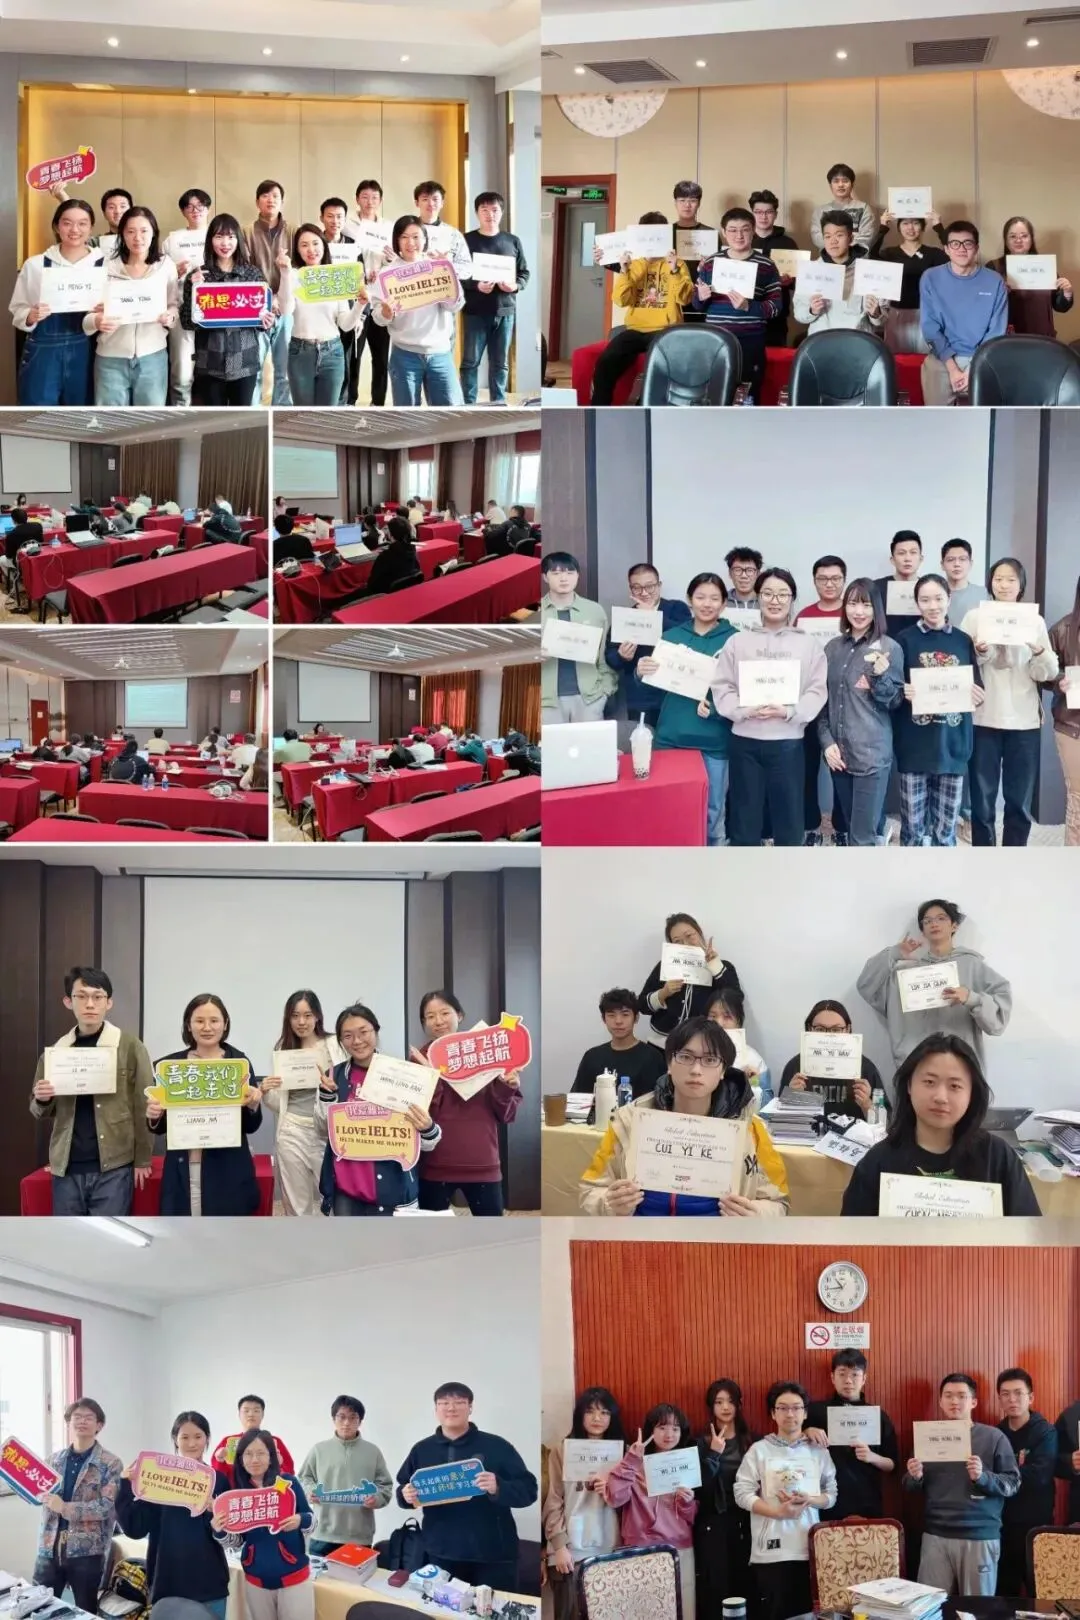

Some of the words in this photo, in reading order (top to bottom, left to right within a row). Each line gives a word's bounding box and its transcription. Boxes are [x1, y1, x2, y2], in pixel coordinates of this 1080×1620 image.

[394, 284, 416, 294] LOVE
[416, 275, 452, 290] IELTS!
[199, 292, 264, 311] 雅思必过
[446, 1030, 509, 1056] 青春飞扬
[447, 1047, 511, 1073] 梦想起航
[166, 1063, 238, 1084] 青春我们
[170, 1082, 240, 1100] 一起走过
[336, 1126, 340, 1134] I
[342, 1126, 366, 1135] LOVE
[368, 1125, 411, 1139] IELTS!
[655, 1143, 672, 1154] CUI
[682, 1146, 693, 1157] YI
[700, 1148, 713, 1159] KE
[3, 1446, 53, 1491] 雅思必过
[141, 1470, 145, 1478] I
[146, 1471, 170, 1483] LOVE
[170, 1475, 208, 1493] IELTS!
[229, 1492, 279, 1511] 青春飞扬
[229, 1506, 279, 1525] 梦想起航
